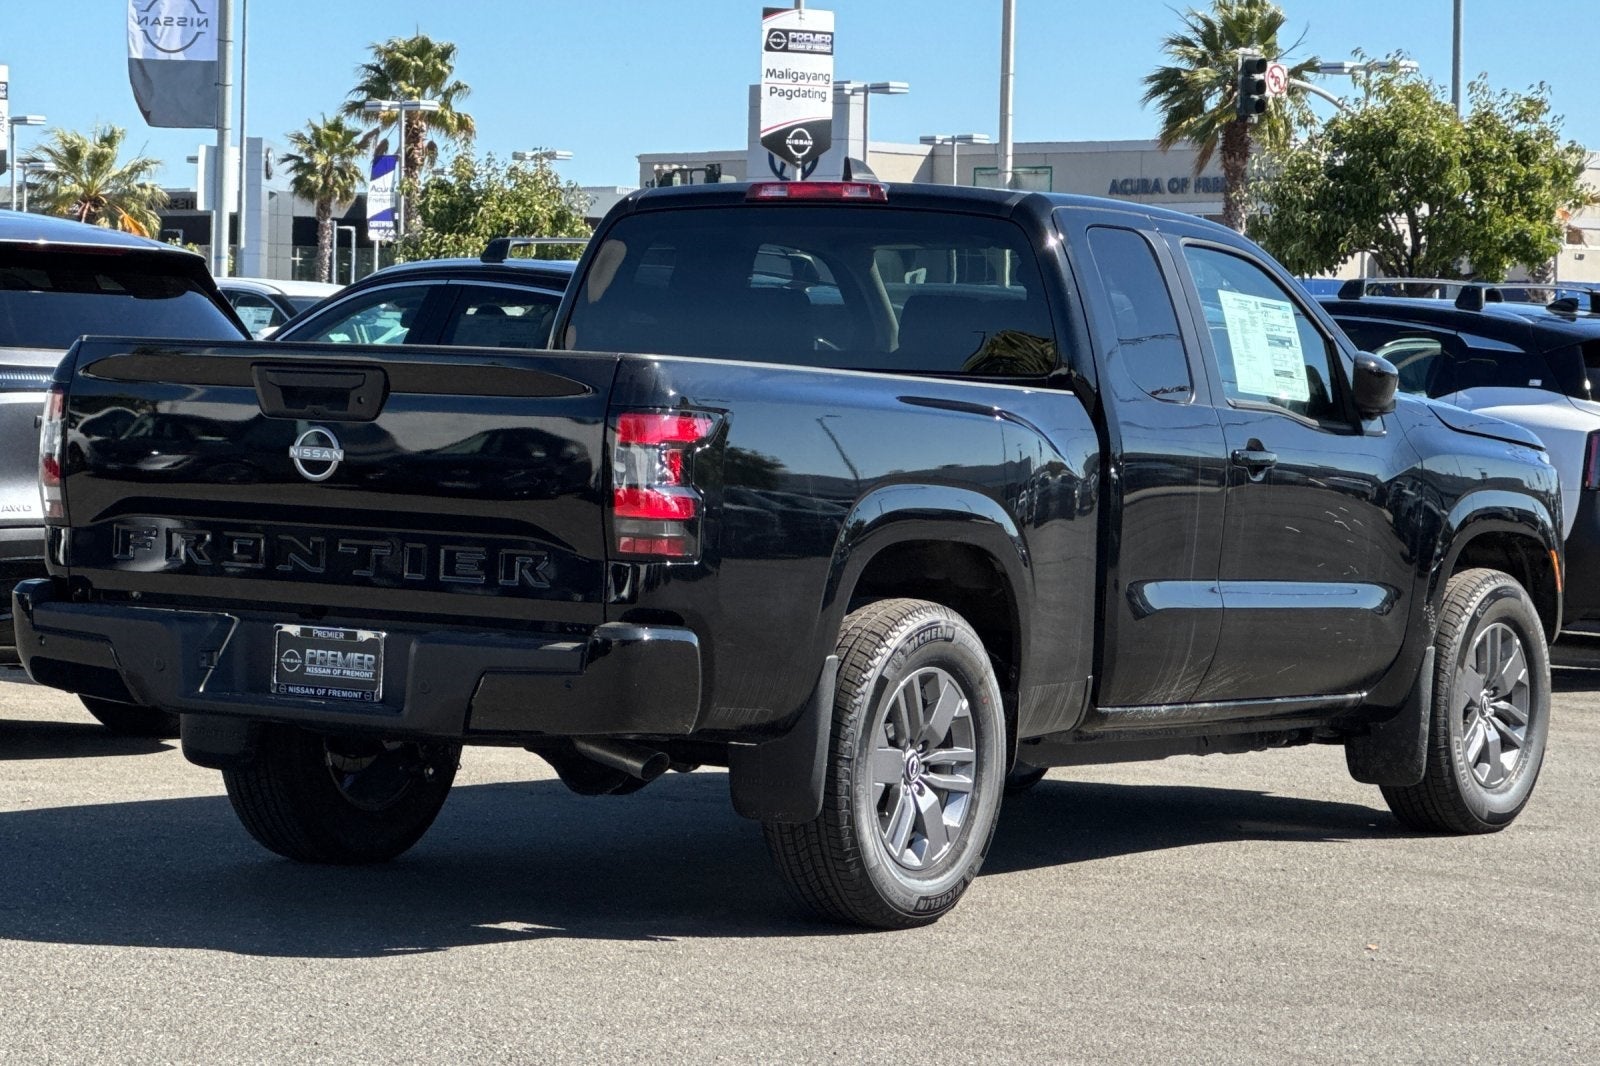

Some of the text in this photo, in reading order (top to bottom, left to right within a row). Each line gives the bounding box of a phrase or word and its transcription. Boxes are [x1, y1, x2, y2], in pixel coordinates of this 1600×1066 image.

[788, 32, 832, 45] PREMIER
[765, 68, 831, 84] Maligayang
[769, 86, 827, 102] Pagdating
[785, 138, 813, 146] NISSAN
[370, 184, 395, 193] Acura
[1108, 178, 1165, 195] ACURA
[1167, 177, 1189, 194] OF
[290, 447, 342, 460] NISSAN
[1, 504, 32, 513] AWD
[113, 523, 551, 589] FRONTIER
[312, 629, 345, 640] PREMIER
[905, 626, 955, 655] MICHELIN
[305, 648, 376, 670] PREMIER
[306, 666, 331, 675] NISSAN
[342, 669, 374, 678] FREMONT
[288, 686, 362, 699] NISSAN OF FREMONT
